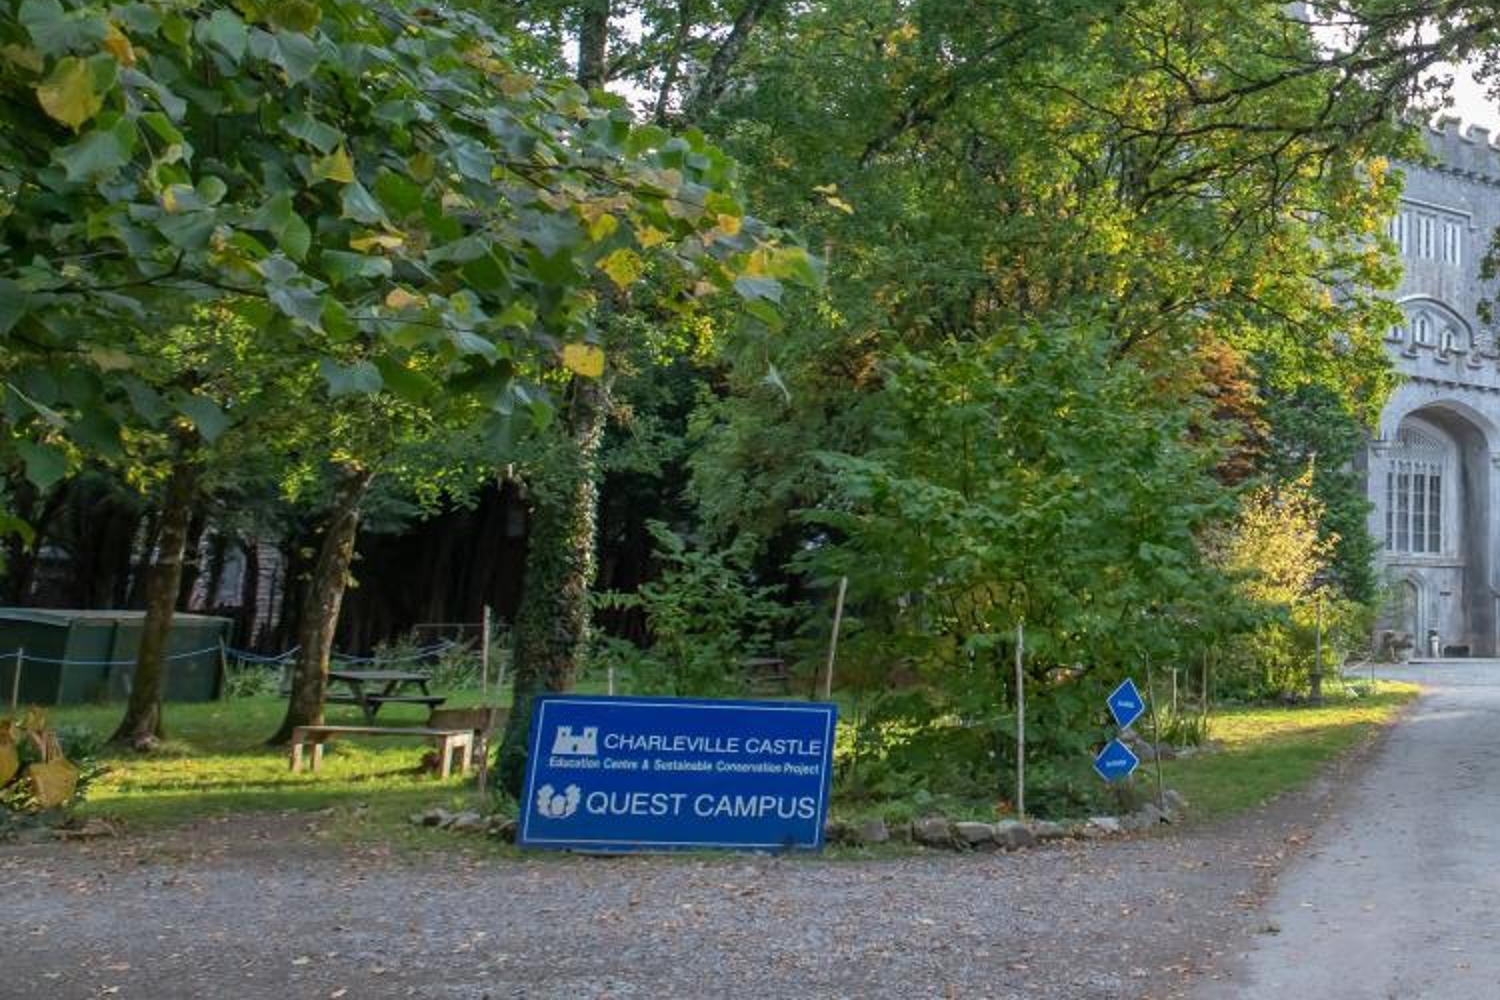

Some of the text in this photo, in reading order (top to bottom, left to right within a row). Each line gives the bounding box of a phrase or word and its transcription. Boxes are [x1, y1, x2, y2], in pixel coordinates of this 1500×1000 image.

[604, 733, 821, 756] CHARLEVILLE CASTLE
[549, 756, 600, 769] Education
[603, 757, 637, 770] Centre
[654, 758, 713, 773] Sustainable
[717, 761, 781, 775] Conservation
[783, 762, 819, 776] Project
[586, 791, 815, 819] QUEST CAMPUS
